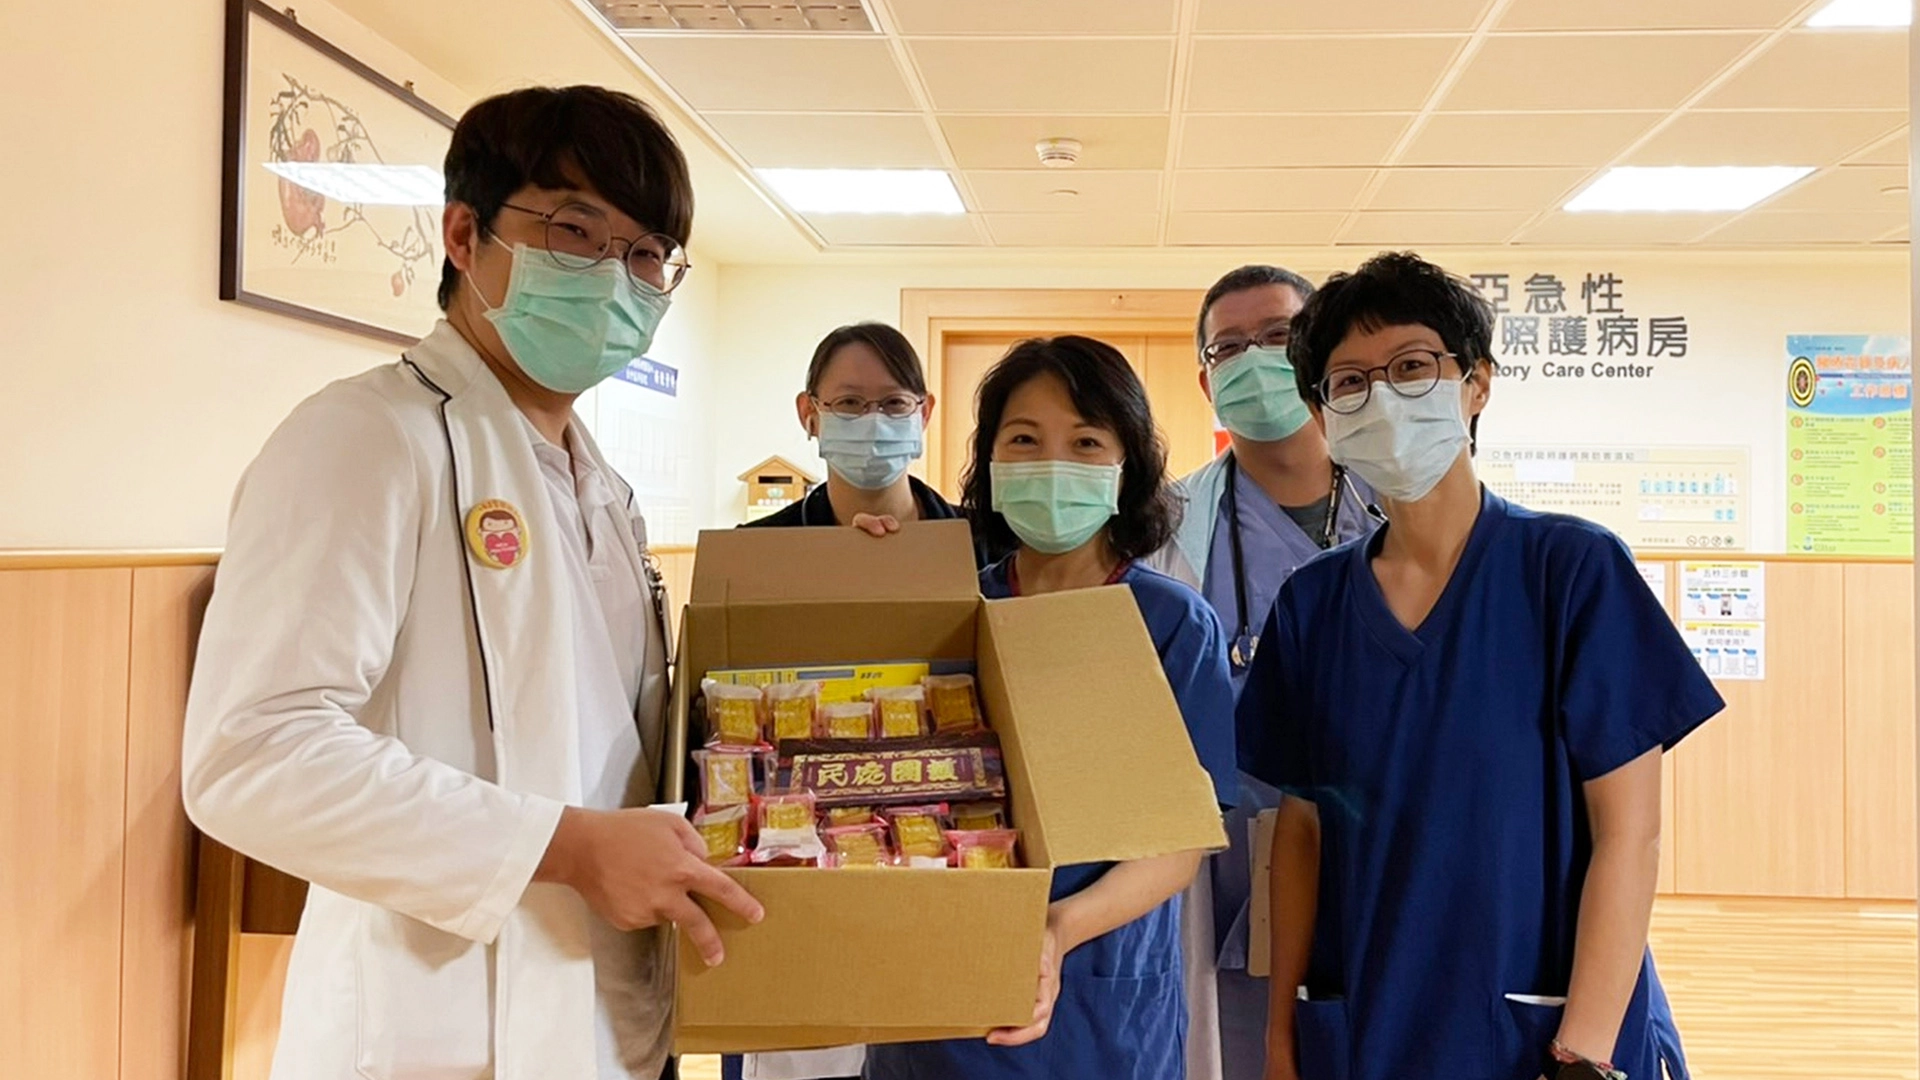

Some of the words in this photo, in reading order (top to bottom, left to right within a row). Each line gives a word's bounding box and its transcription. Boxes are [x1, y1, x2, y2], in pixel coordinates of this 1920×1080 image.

[1470, 272, 1625, 314] 亞急性
[1502, 315, 1689, 358] 照護病房
[1542, 362, 1585, 378] Care
[1591, 362, 1654, 378] Center
